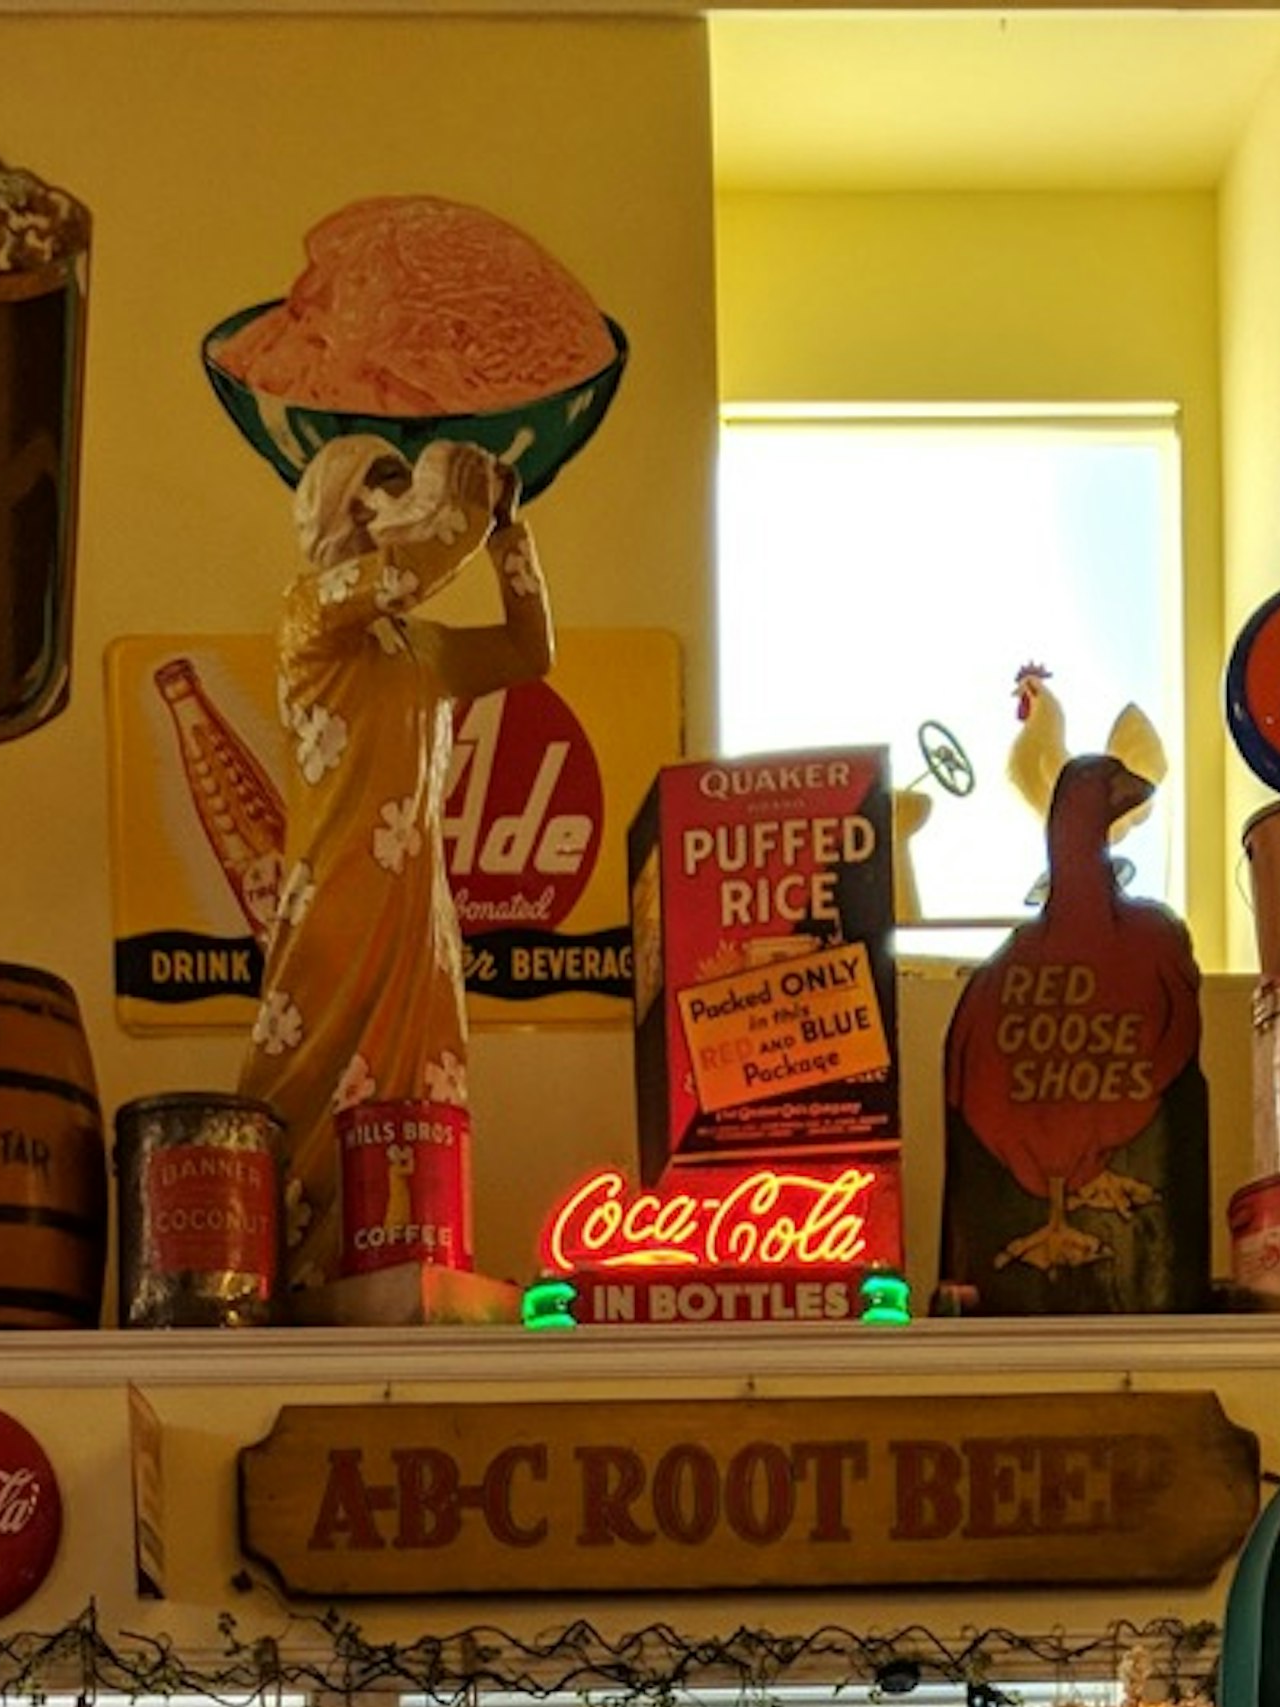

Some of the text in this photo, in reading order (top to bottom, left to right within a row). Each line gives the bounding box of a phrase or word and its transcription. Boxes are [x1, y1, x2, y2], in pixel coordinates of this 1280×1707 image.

[700, 761, 850, 799] QUAKER
[683, 815, 876, 876] PUFFED
[453, 884, 555, 921] bonated
[721, 872, 839, 927] RICE
[151, 950, 252, 984] DRINK
[511, 946, 632, 981] BEVERAG
[690, 957, 860, 1023] Packed ONLY
[1001, 964, 1097, 1006] RED
[699, 1006, 871, 1071] RED AND BLUE
[996, 1012, 1144, 1055] GOOSE
[743, 1051, 840, 1088] Package
[1009, 1060, 1153, 1102] SHOES
[161, 1158, 261, 1189] BANNER
[156, 1208, 268, 1233] COCONUT
[354, 1224, 454, 1250] COFFEE
[552, 1169, 876, 1270] Coca-Cola
[593, 1282, 850, 1321] IN BOTTLES
[573, 1440, 868, 1549] ROOT
